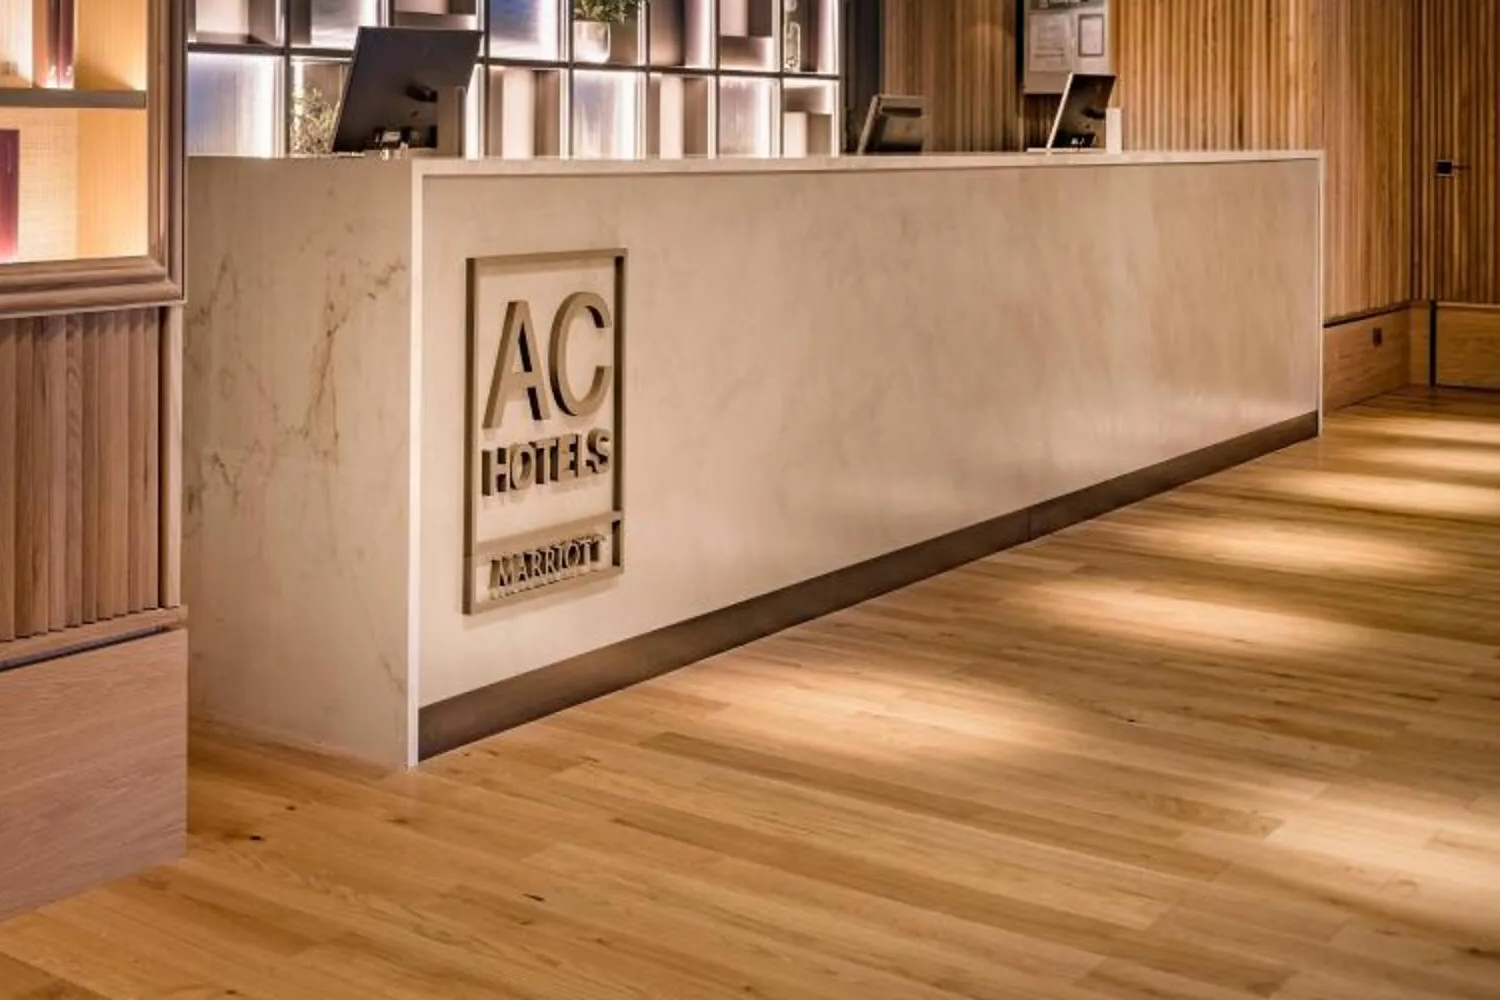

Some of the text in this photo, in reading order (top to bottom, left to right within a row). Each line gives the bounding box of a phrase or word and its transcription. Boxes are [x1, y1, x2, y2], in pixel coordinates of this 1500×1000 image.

[482, 291, 613, 430] AC
[481, 427, 612, 497] HOTELS
[489, 534, 607, 590] MARRIOTT
